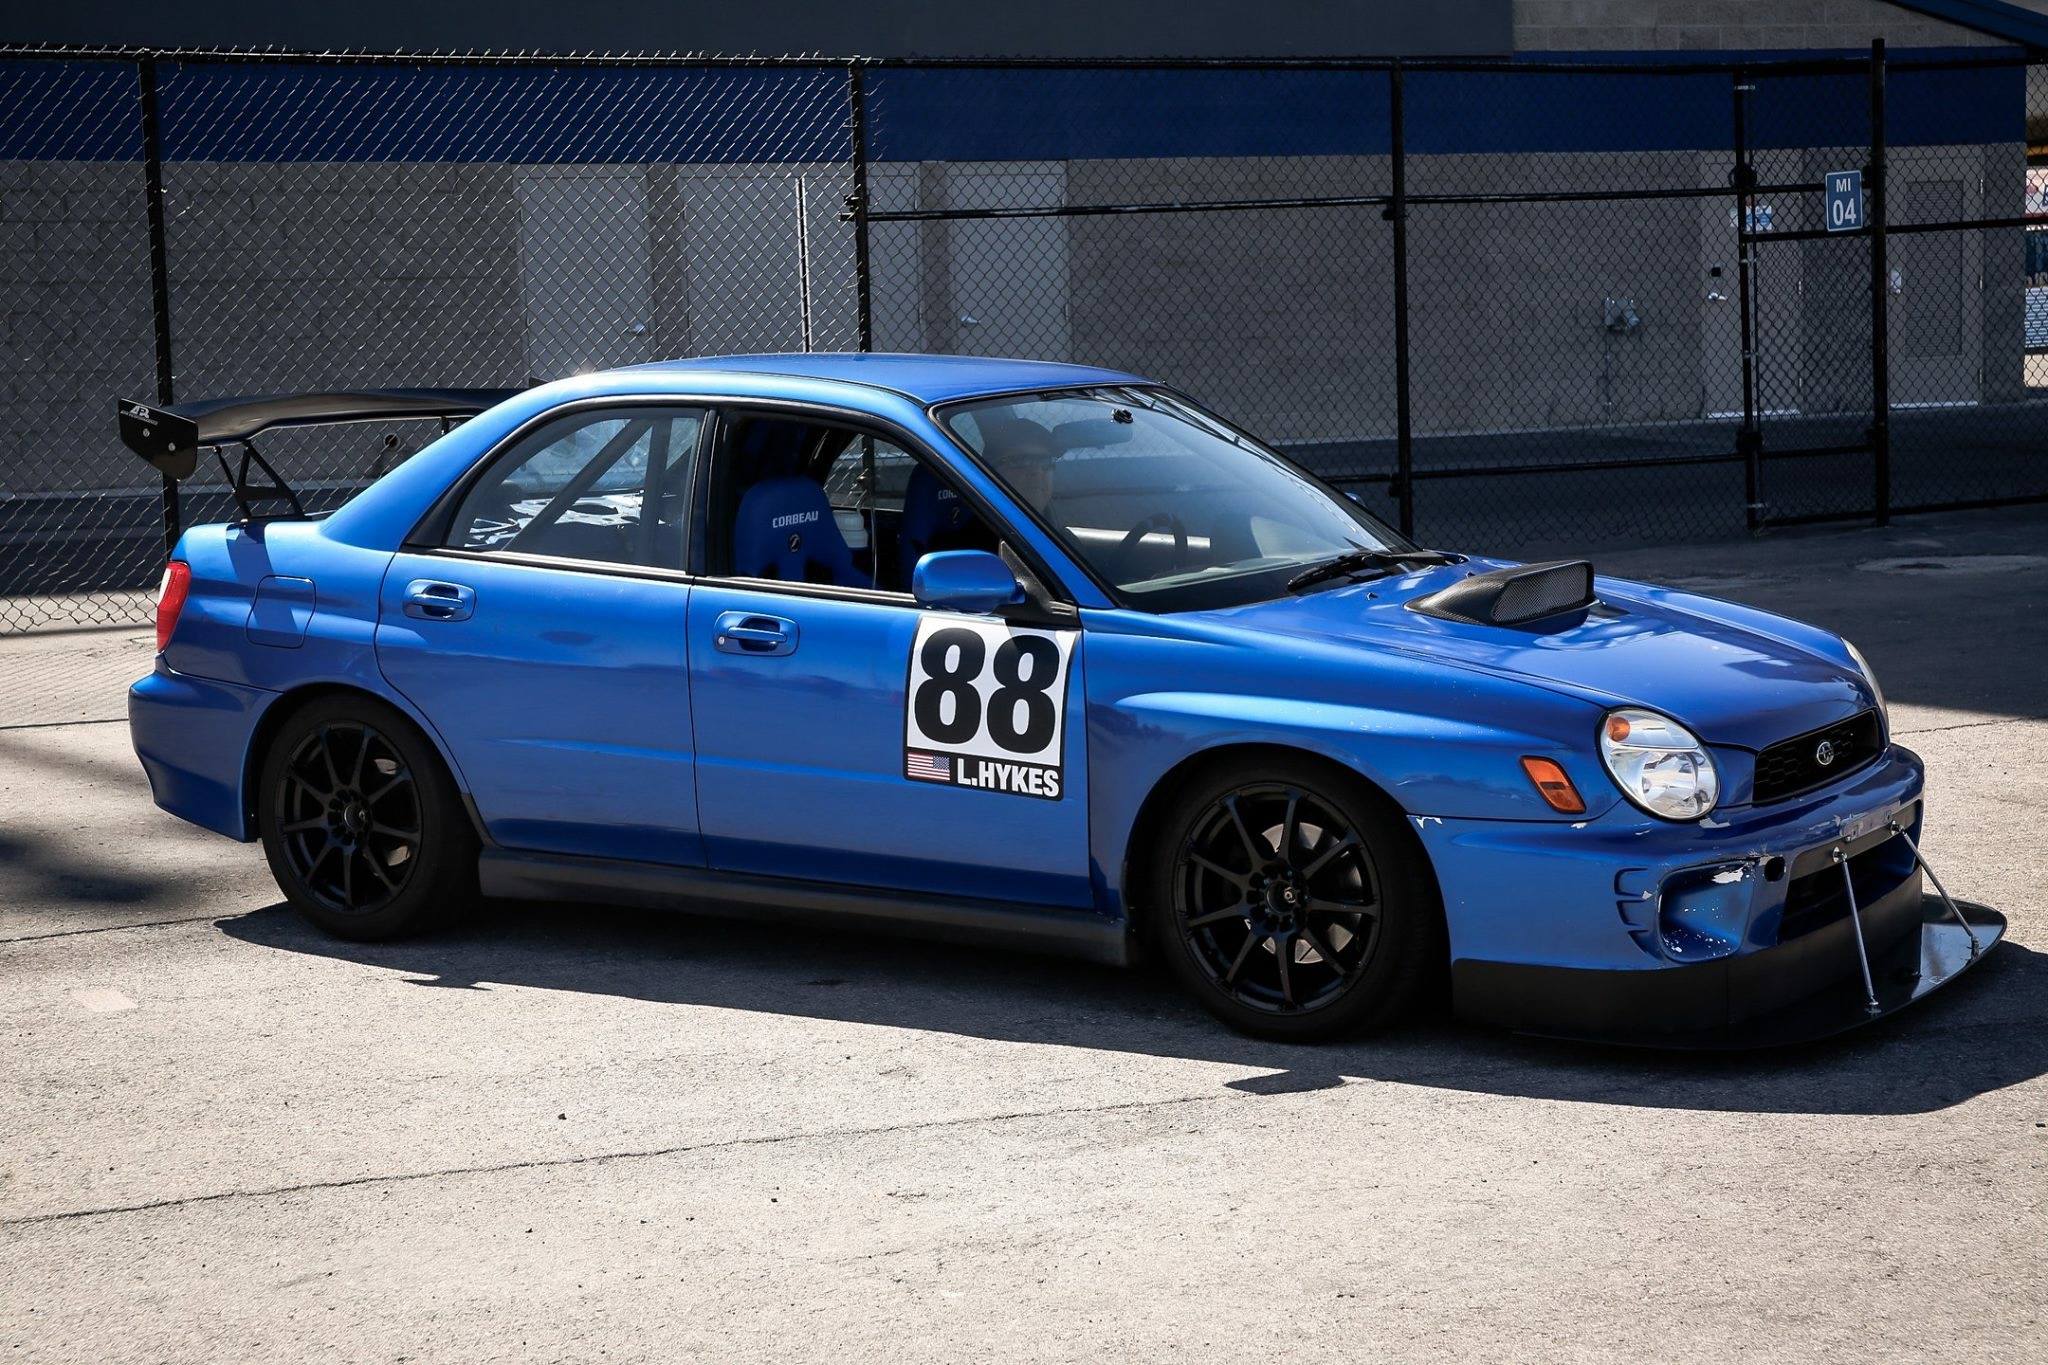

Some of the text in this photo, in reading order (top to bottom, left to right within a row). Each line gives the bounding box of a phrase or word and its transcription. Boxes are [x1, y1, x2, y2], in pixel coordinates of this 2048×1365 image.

[1836, 178, 1851, 192] MI
[1833, 198, 1857, 226] 04
[772, 510, 819, 528] CORBEAU
[914, 627, 1060, 754] 88
[957, 758, 1060, 797] L.HYKES
